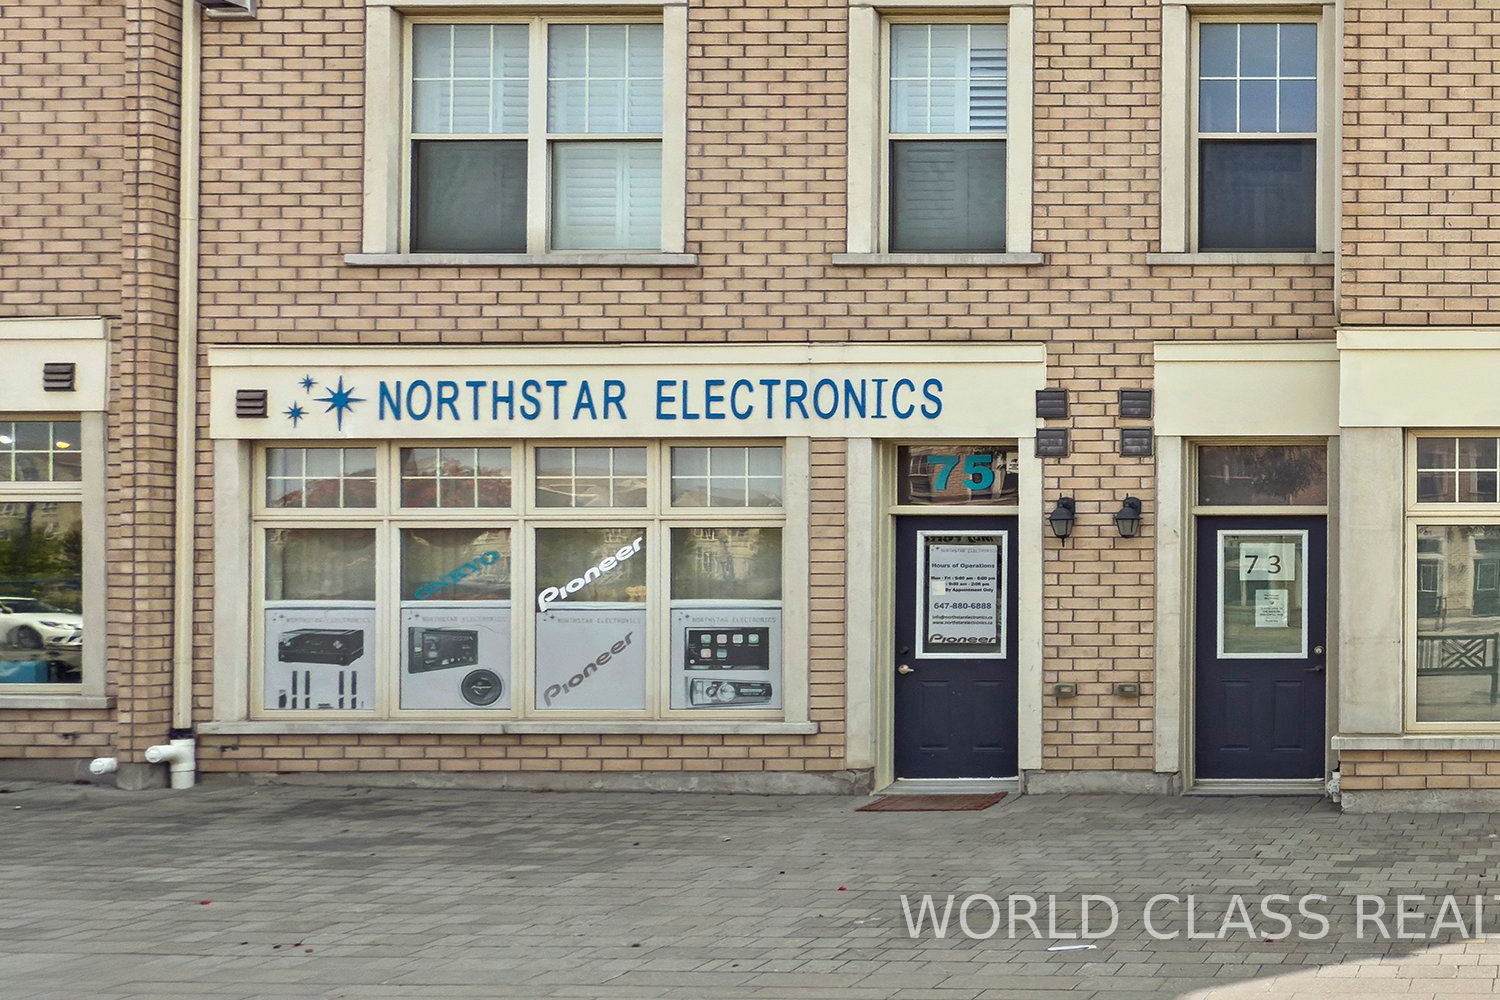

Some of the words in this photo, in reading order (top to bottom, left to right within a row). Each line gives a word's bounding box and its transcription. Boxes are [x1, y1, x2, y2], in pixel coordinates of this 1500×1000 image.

[378, 379, 627, 420] NORTHSTAR
[656, 378, 943, 420] ELECTRONICS
[927, 454, 995, 491] 75
[538, 536, 642, 612] Pioneer
[930, 633, 996, 643] Pioneer
[543, 631, 633, 707] Pioneer
